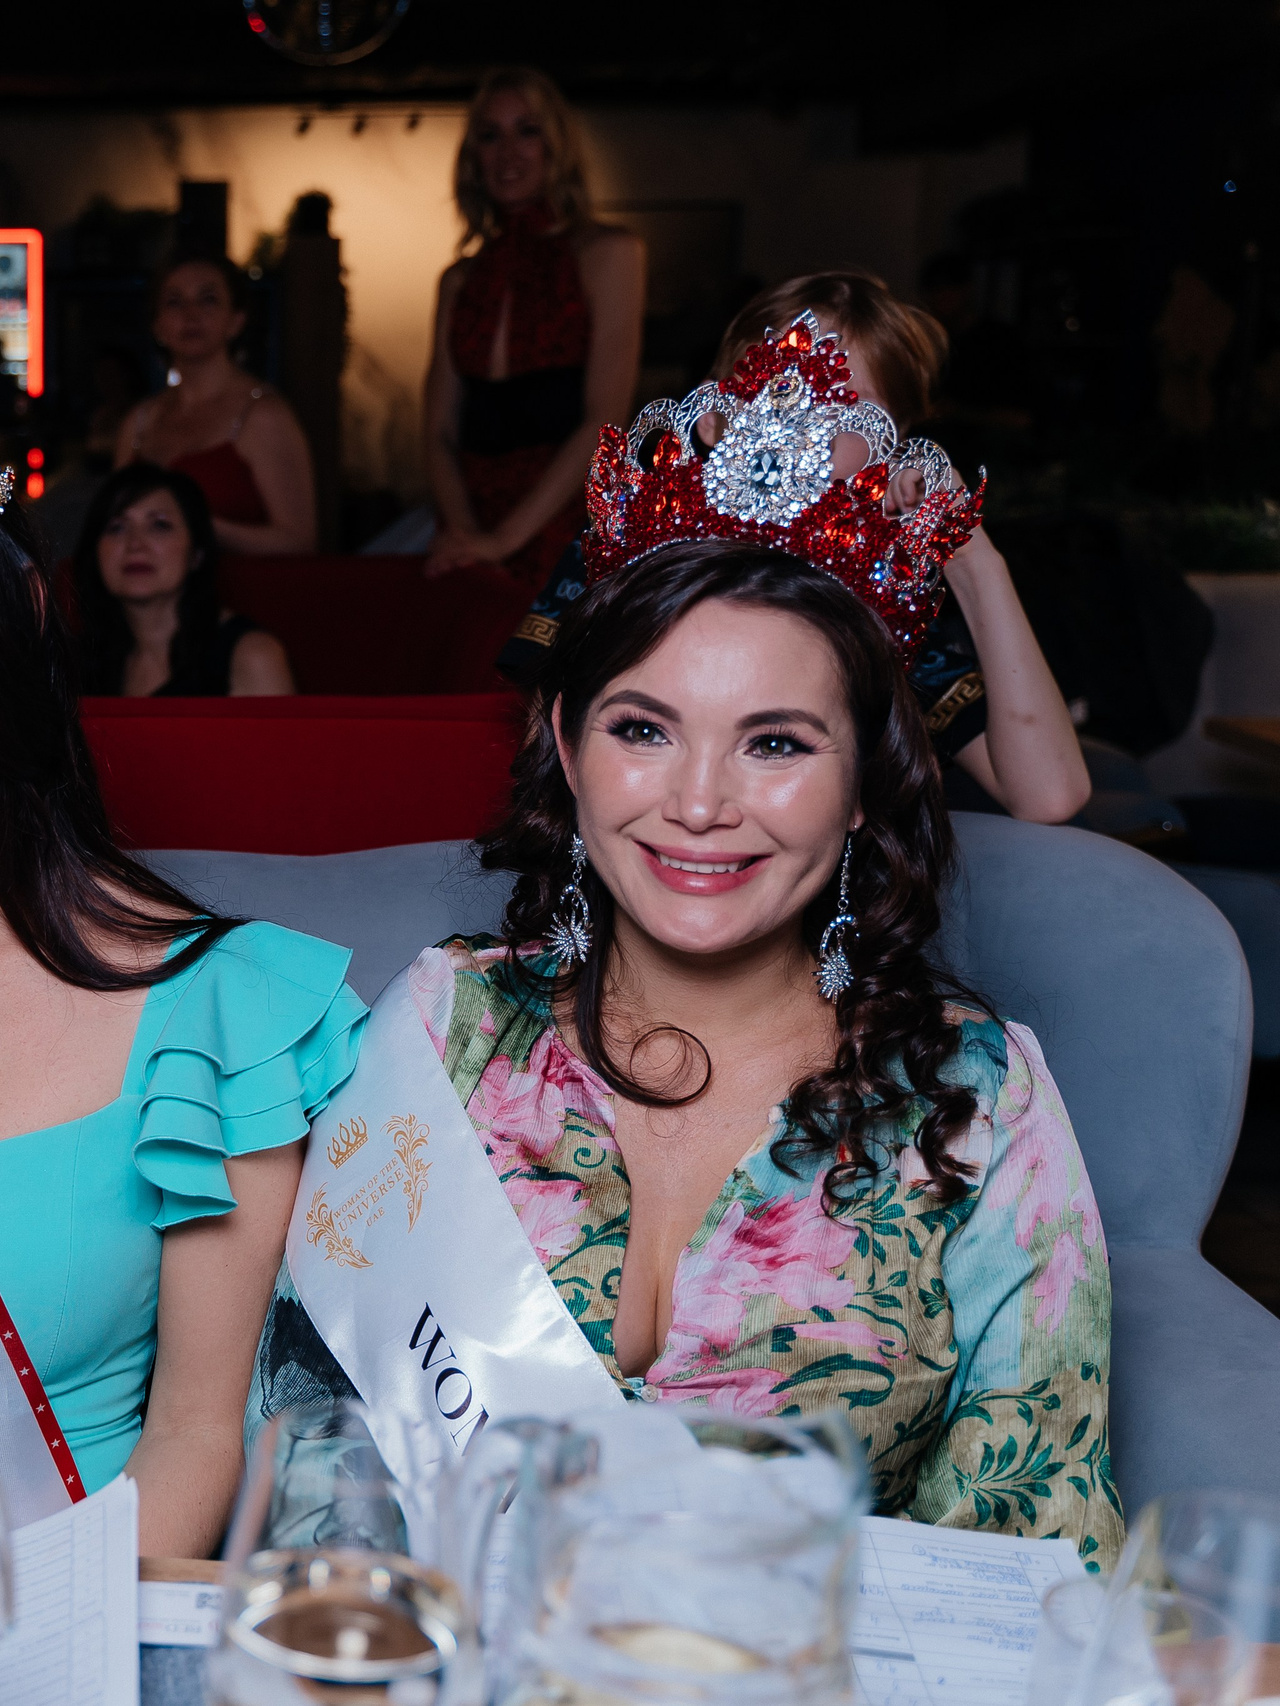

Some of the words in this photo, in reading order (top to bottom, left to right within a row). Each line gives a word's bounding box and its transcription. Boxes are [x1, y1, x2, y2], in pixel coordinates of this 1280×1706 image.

[332, 1186, 367, 1220] WOMAN
[367, 1174, 379, 1190] OF
[379, 1156, 399, 1178] THE
[337, 1167, 405, 1233] UNIVERSE
[365, 1206, 386, 1228] UAE
